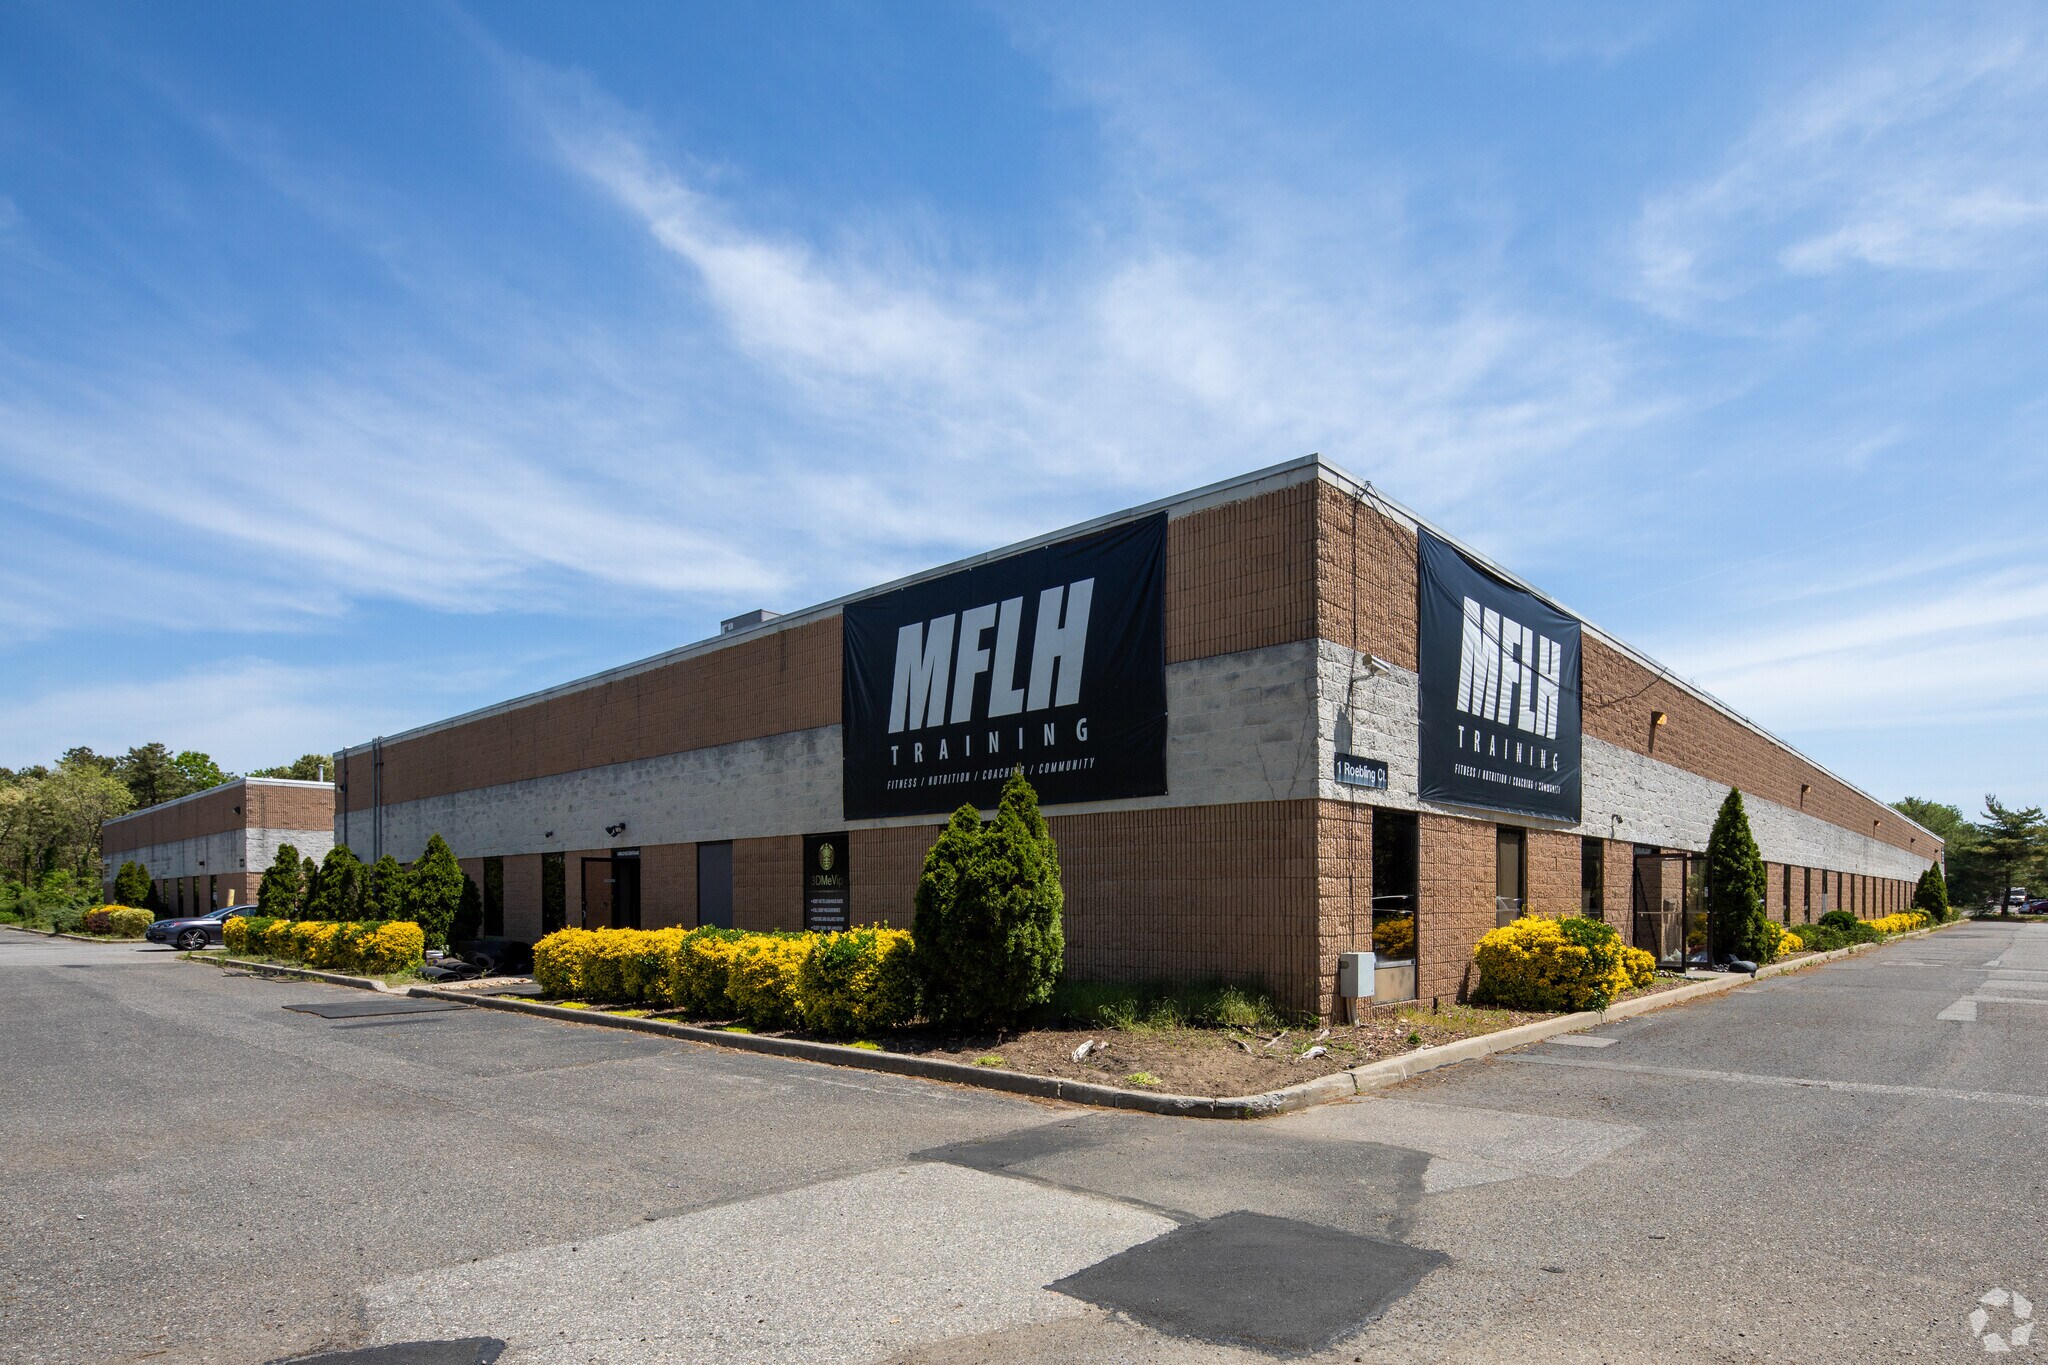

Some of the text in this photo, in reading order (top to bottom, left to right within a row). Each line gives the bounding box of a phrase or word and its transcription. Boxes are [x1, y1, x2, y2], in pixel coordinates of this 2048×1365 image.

[888, 577, 1095, 734] MFLH
[1456, 595, 1561, 740] MFLH
[891, 718, 1088, 766] TRAINING
[1458, 725, 1558, 772] TRAINING
[887, 778, 917, 790] FITNESS
[928, 772, 970, 786] NUTRITION
[1039, 757, 1095, 774] COMMUNITY
[1337, 761, 1342, 774] 1
[1344, 762, 1376, 783] Roebling
[1455, 763, 1476, 778] FITNESS
[1482, 769, 1507, 785] NUTRITION
[1513, 776, 1533, 790] COACHING
